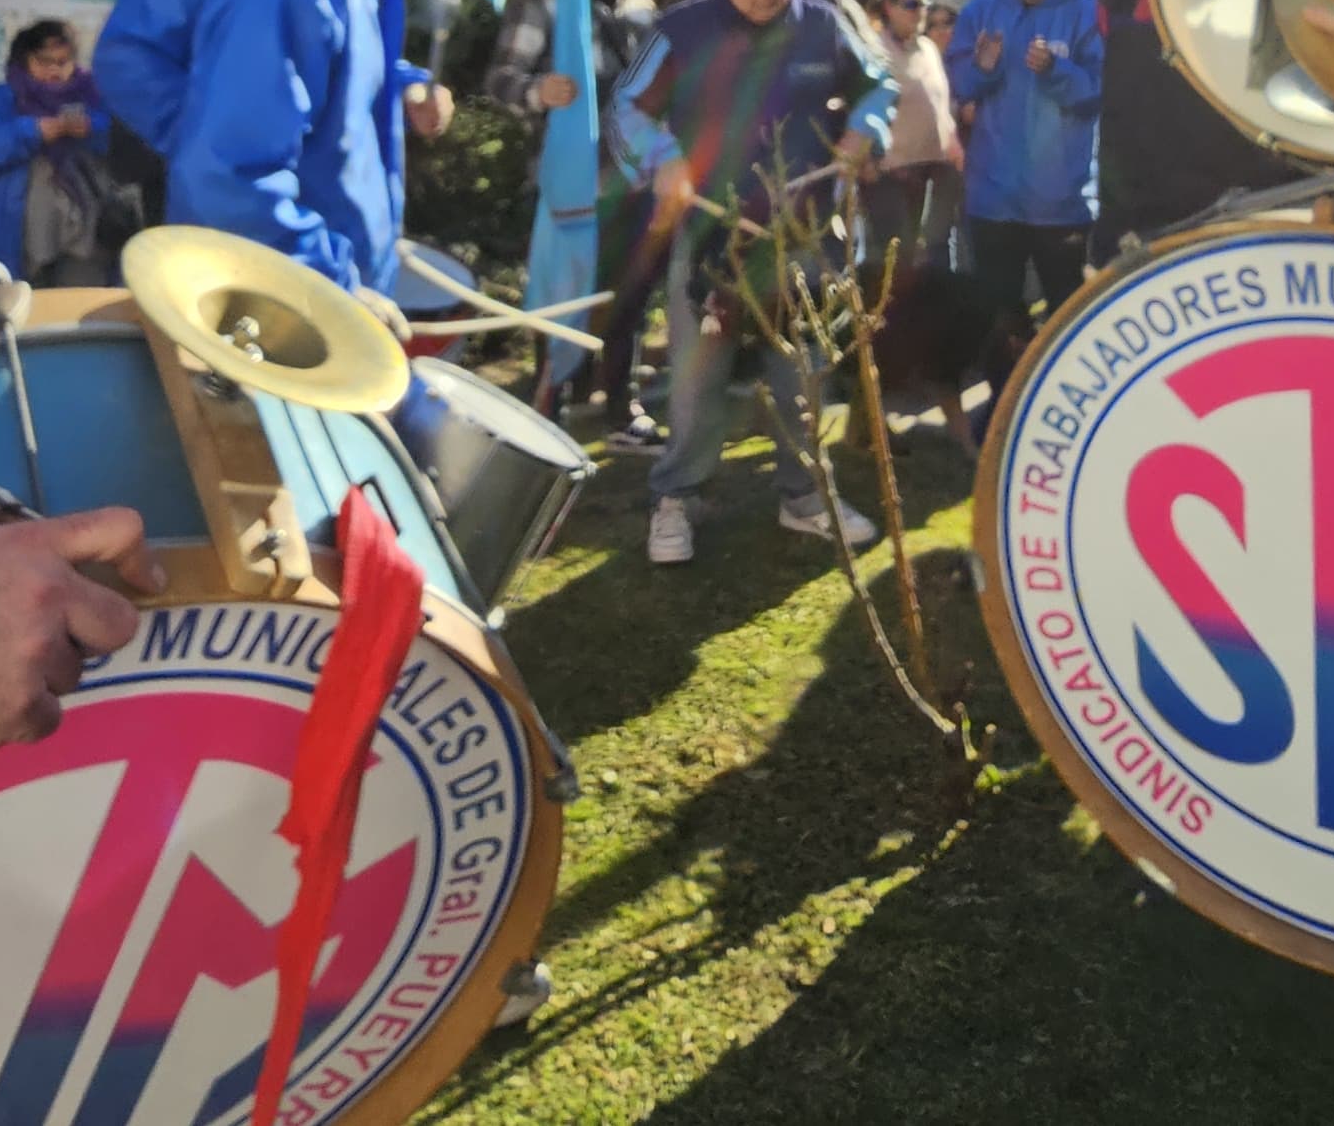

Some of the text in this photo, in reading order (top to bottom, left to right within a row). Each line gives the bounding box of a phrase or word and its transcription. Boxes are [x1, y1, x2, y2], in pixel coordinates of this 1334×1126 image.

[1019, 266, 1268, 519] TRABAJADORES
[1020, 535, 1065, 592] DE
[1036, 610, 1215, 836] SINDICATO
[445, 759, 506, 831] DE
[428, 835, 503, 937] Gral.
